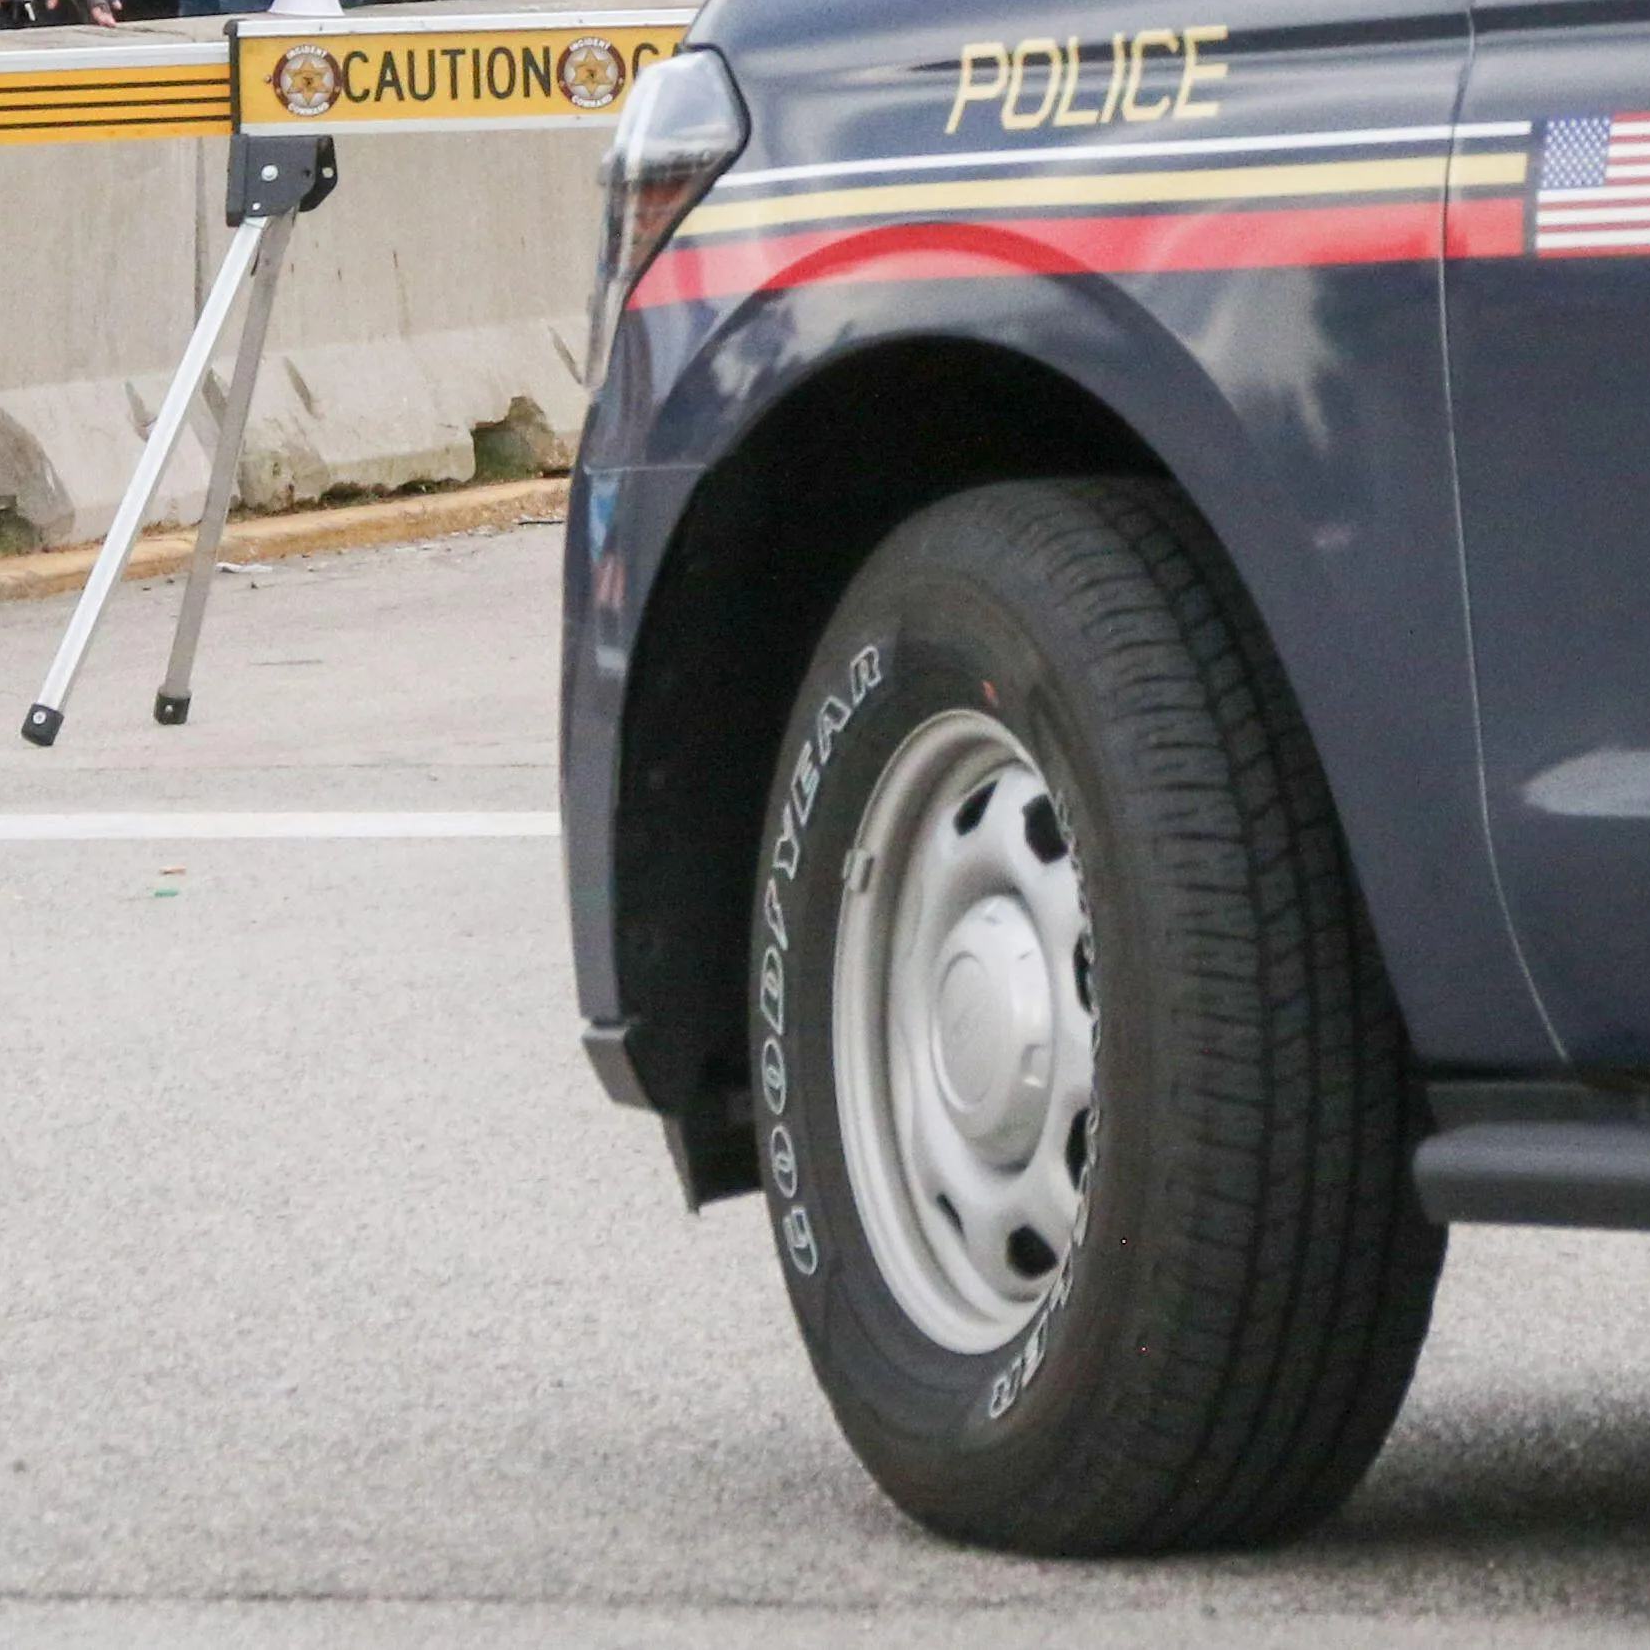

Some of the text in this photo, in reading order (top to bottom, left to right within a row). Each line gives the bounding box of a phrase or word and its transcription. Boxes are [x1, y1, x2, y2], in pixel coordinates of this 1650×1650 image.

[342, 45, 551, 104] CAUTION
[944, 24, 1229, 135] POLICE
[759, 645, 883, 1276] GOODYEAR
